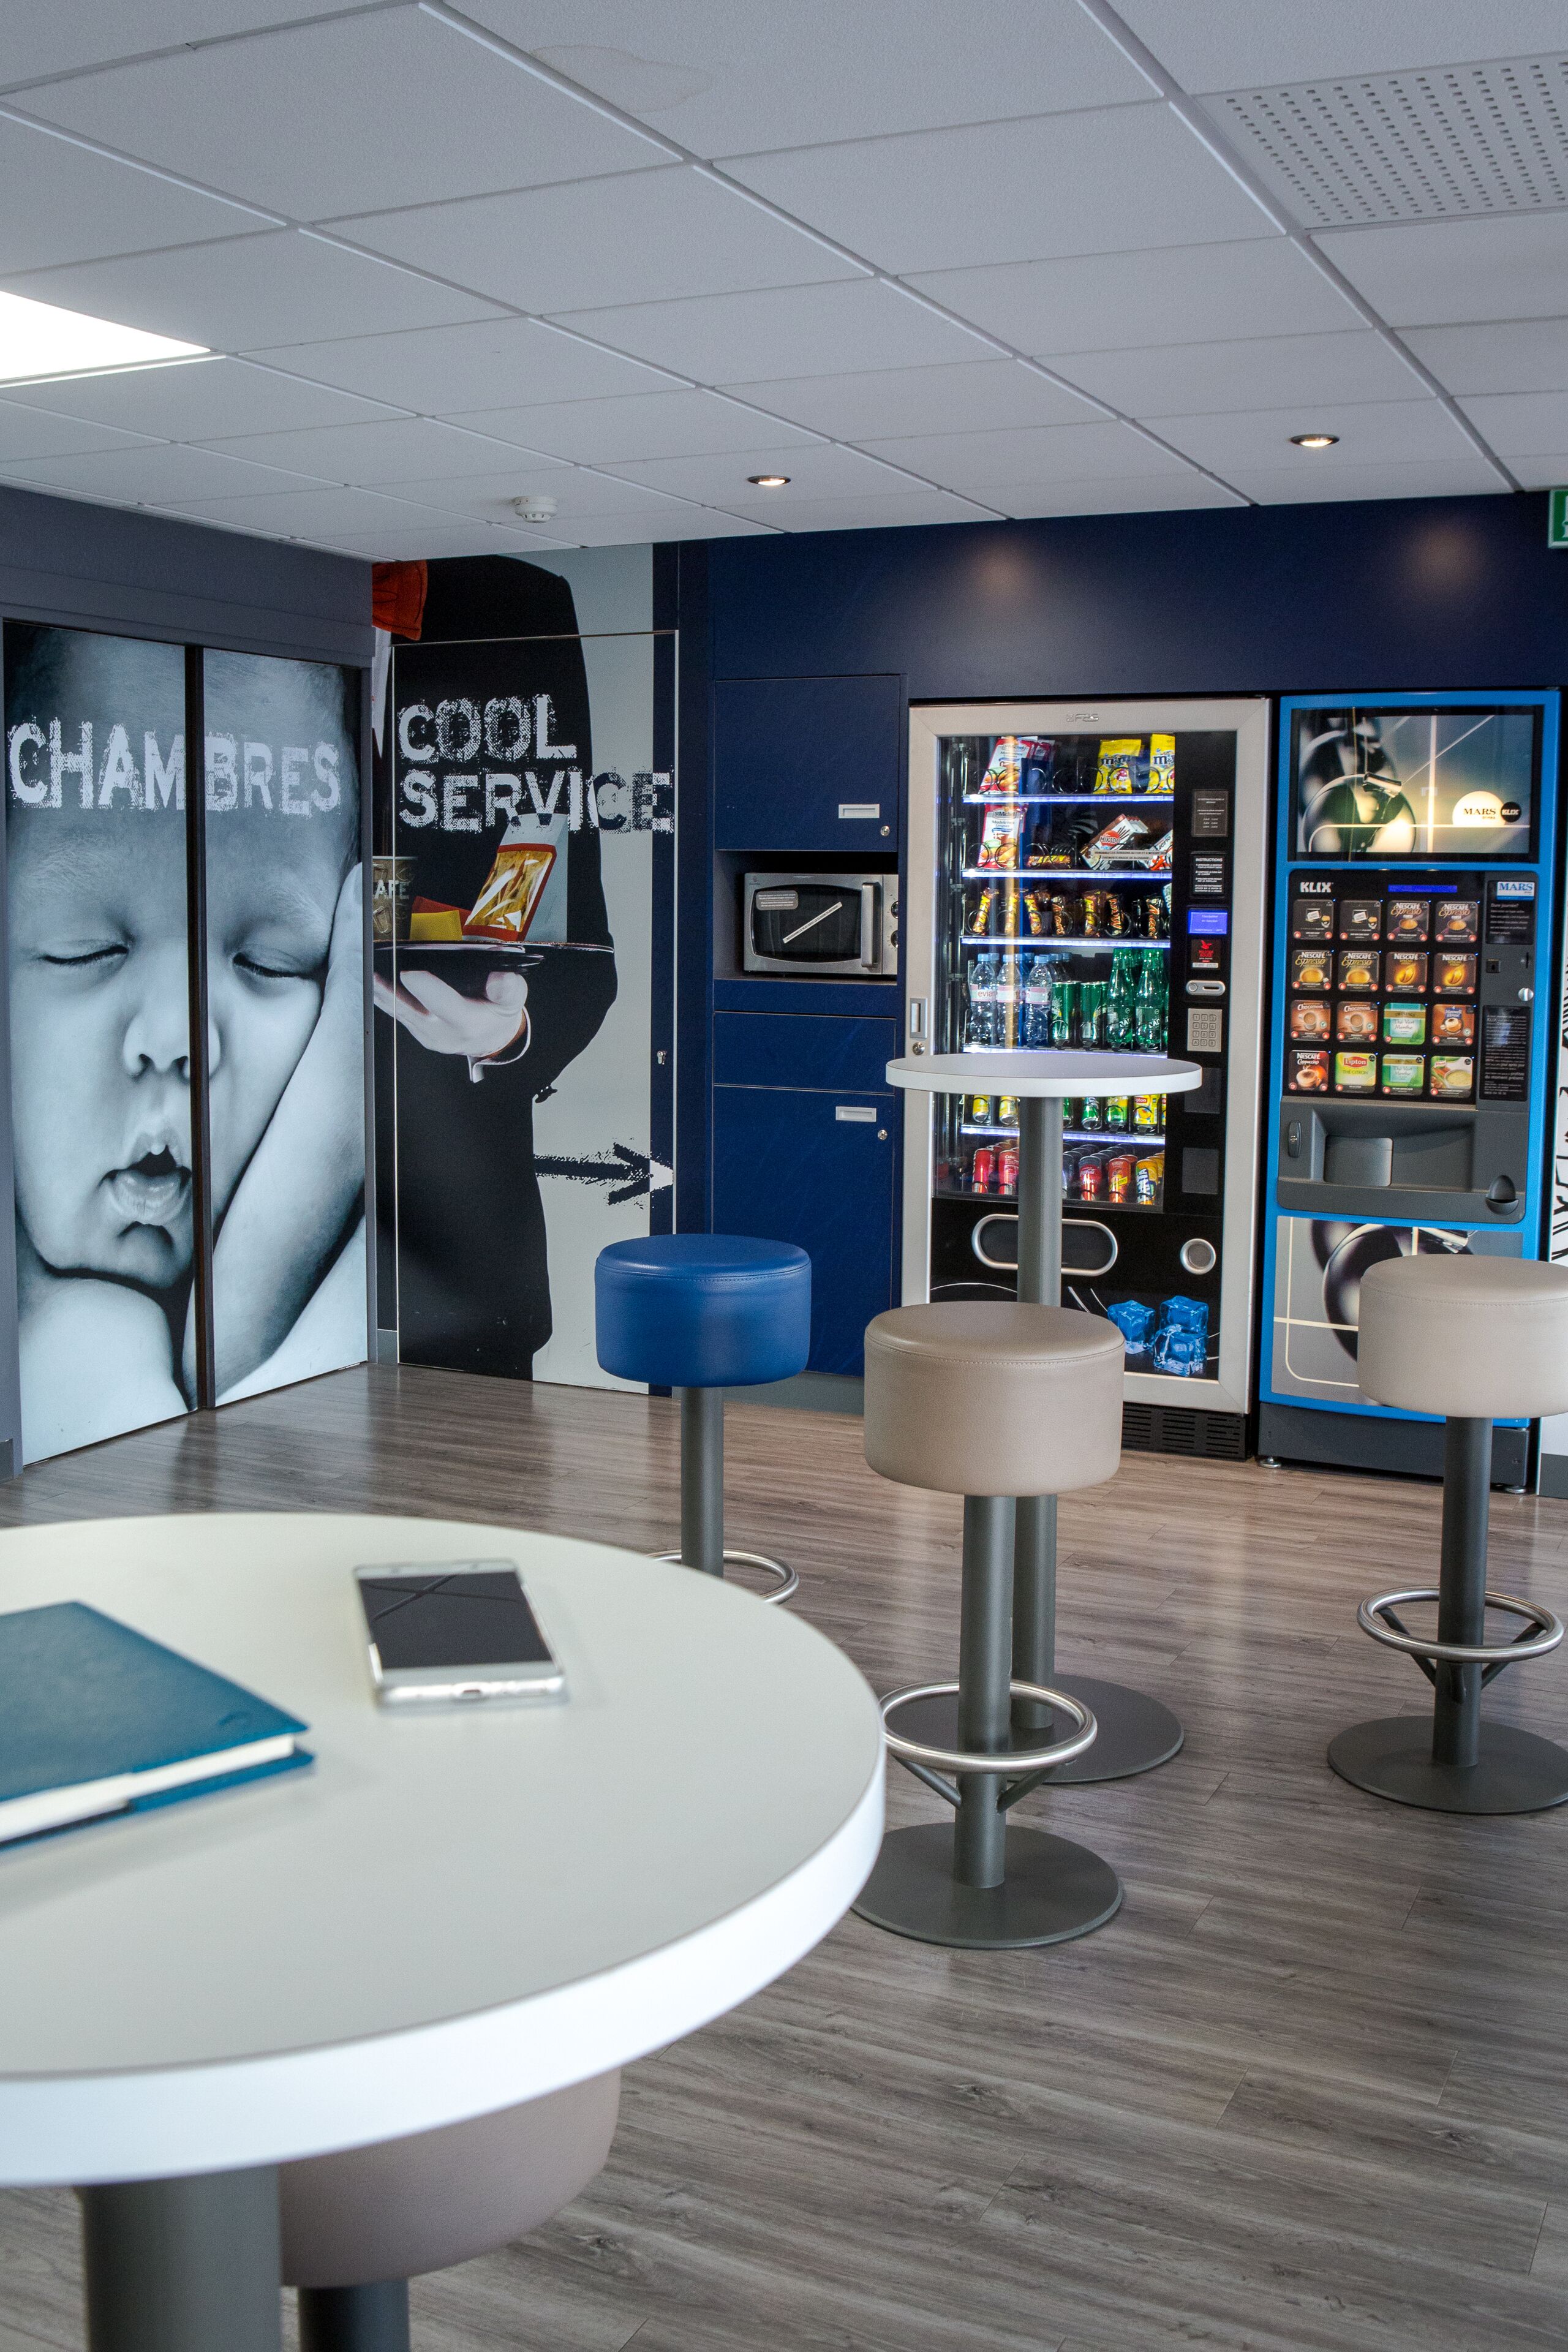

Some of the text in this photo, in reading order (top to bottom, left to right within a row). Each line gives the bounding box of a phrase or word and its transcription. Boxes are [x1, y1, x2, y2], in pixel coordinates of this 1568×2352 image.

[397, 694, 577, 764] COOL
[399, 766, 675, 833] SERVICE
[1099, 835, 1121, 844] MIKADO
[374, 879, 410, 900] AFE
[1300, 881, 1332, 893] KLIX
[1499, 883, 1534, 891] MARS
